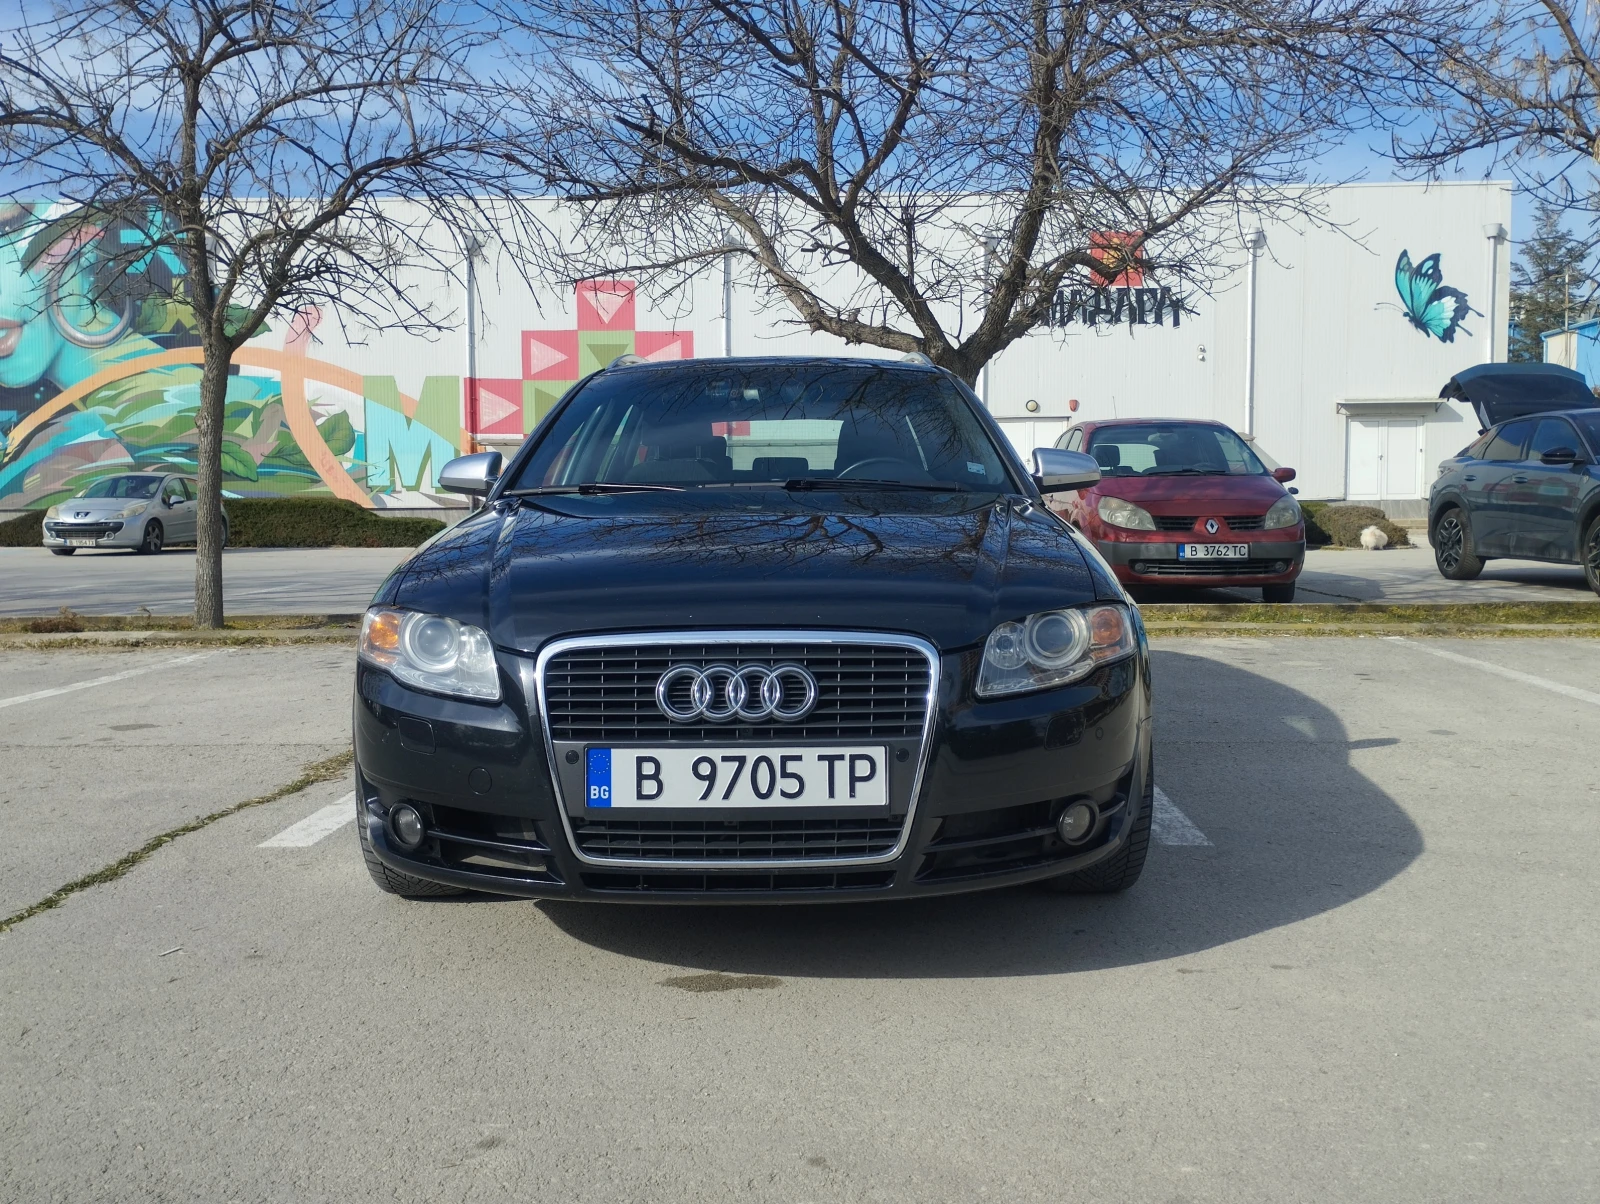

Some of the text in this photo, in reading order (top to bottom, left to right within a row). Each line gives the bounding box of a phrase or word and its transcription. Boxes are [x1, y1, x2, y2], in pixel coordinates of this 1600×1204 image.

[1190, 545, 1198, 557] B
[1203, 545, 1230, 557] 3762
[1231, 545, 1246, 557] TC
[635, 753, 877, 801] B 9705 TP
[590, 785, 610, 799] BG
